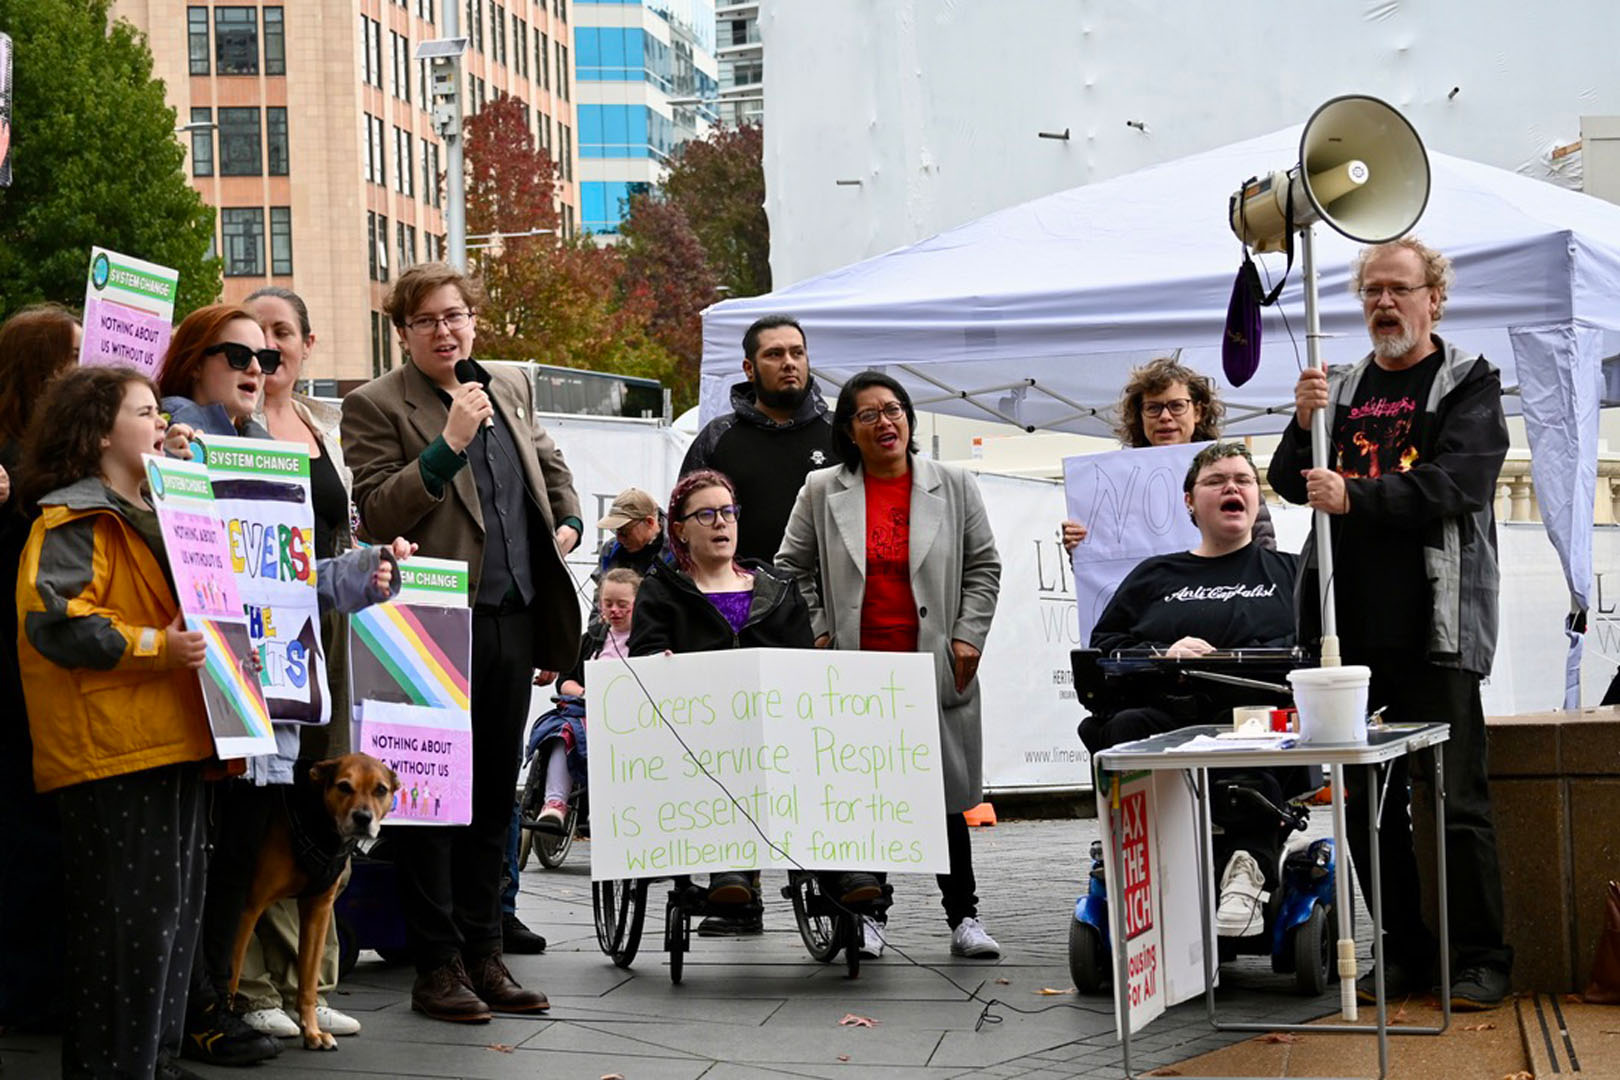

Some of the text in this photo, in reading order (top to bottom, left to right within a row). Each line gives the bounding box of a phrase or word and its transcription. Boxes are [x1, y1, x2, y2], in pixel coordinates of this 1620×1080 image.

[111, 269, 170, 296] SYSTEM CHANGE
[101, 316, 159, 343] NOTHING ABOUT
[101, 339, 154, 365] US WITHOUT US
[210, 451, 299, 472] SYSTEM CHANGE
[221, 518, 317, 588] EVERSE
[416, 573, 458, 588] CHANGE
[603, 665, 915, 735] Carers are a front-
[372, 735, 452, 754] NOTHING ABOUT
[610, 744, 668, 783] line
[811, 726, 931, 788] Respite
[1024, 746, 1088, 763] www.limewo
[390, 759, 449, 777] WITHOUT US
[610, 784, 914, 838] is essential for the
[1122, 794, 1144, 844] AX
[626, 829, 924, 871] wellbeing of families
[1125, 884, 1152, 936] ICH
[1128, 943, 1156, 978] ousing
